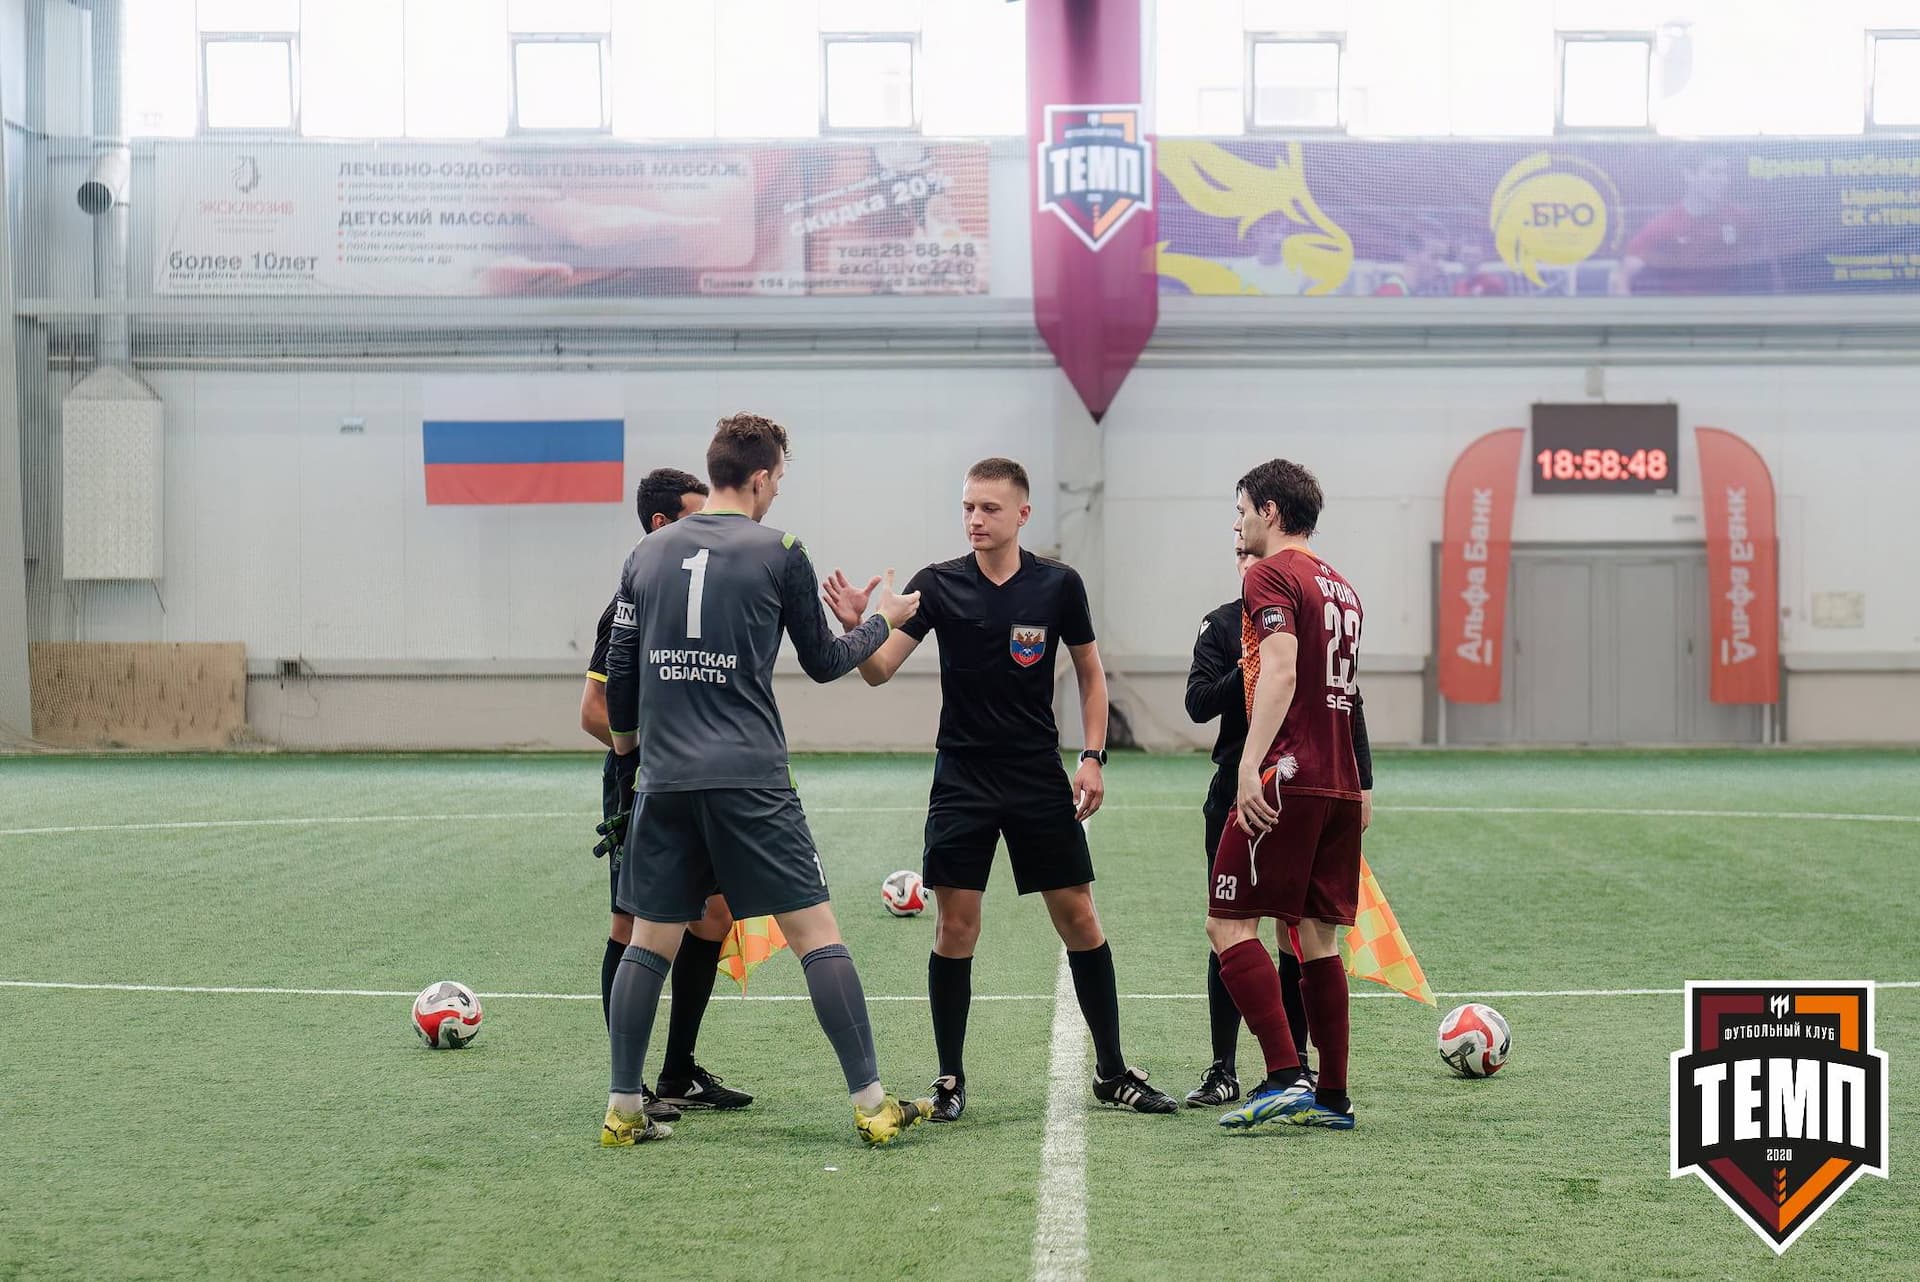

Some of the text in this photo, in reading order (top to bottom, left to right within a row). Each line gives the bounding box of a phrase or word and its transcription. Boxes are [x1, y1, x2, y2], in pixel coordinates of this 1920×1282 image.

[1049, 145, 1142, 195] ТЕМП
[892, 168, 955, 205] 20%
[338, 209, 432, 227] ДЕТСКИЙ
[170, 251, 242, 270] более
[1537, 448, 1668, 481] 18:58:48
[1456, 487, 1493, 665] Альфа Банк
[681, 548, 709, 639] 1
[1264, 613, 1283, 626] ТЕМП
[649, 649, 738, 669] ИРКУТСКАЯ
[1324, 602, 1361, 695] 23
[659, 665, 727, 684] ОБЛАСТЬ
[1215, 873, 1238, 900] 23
